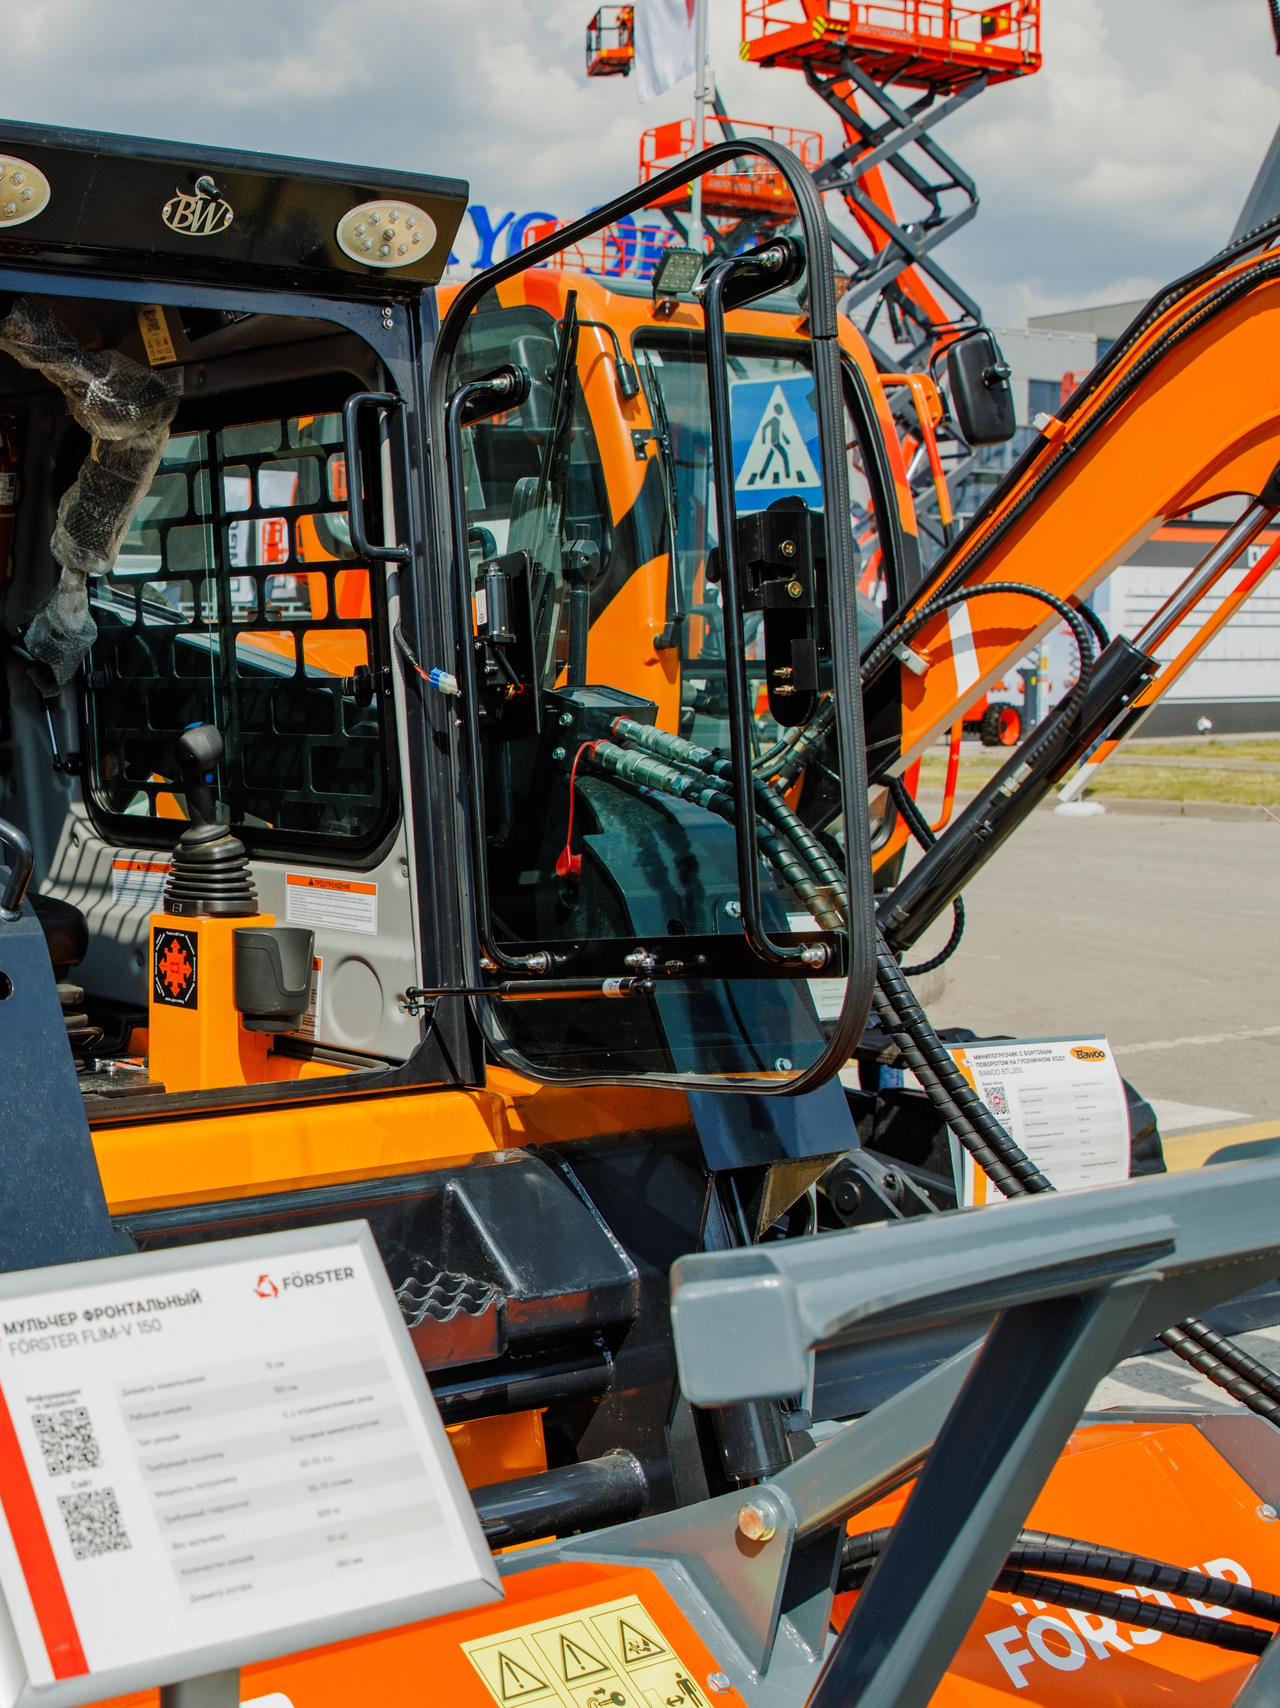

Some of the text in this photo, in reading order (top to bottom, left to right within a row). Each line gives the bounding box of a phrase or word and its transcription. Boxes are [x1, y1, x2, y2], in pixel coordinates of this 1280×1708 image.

[171, 192, 228, 235] BW
[314, 879, 351, 890] ПРЕДУПРЕЖДЕНИЕ
[973, 1051, 1018, 1060] МИНИПОГРУЗЧИК
[1024, 1049, 1052, 1057] БОРТОВЫМ
[1073, 1048, 1106, 1060] Bawoo
[975, 1055, 1066, 1068] ПОВОРОТОМ НА ГУСЕНИЧНОМ ХОДУ
[978, 1066, 1023, 1077] BAWOO BTL350
[282, 1266, 355, 1291] FÖRSTER
[3, 1289, 203, 1337] МУЛЬЧЕР ФРОНТАЛЬНЫЙ
[8, 1331, 79, 1357] FÖRSTER
[136, 1318, 162, 1335] 150
